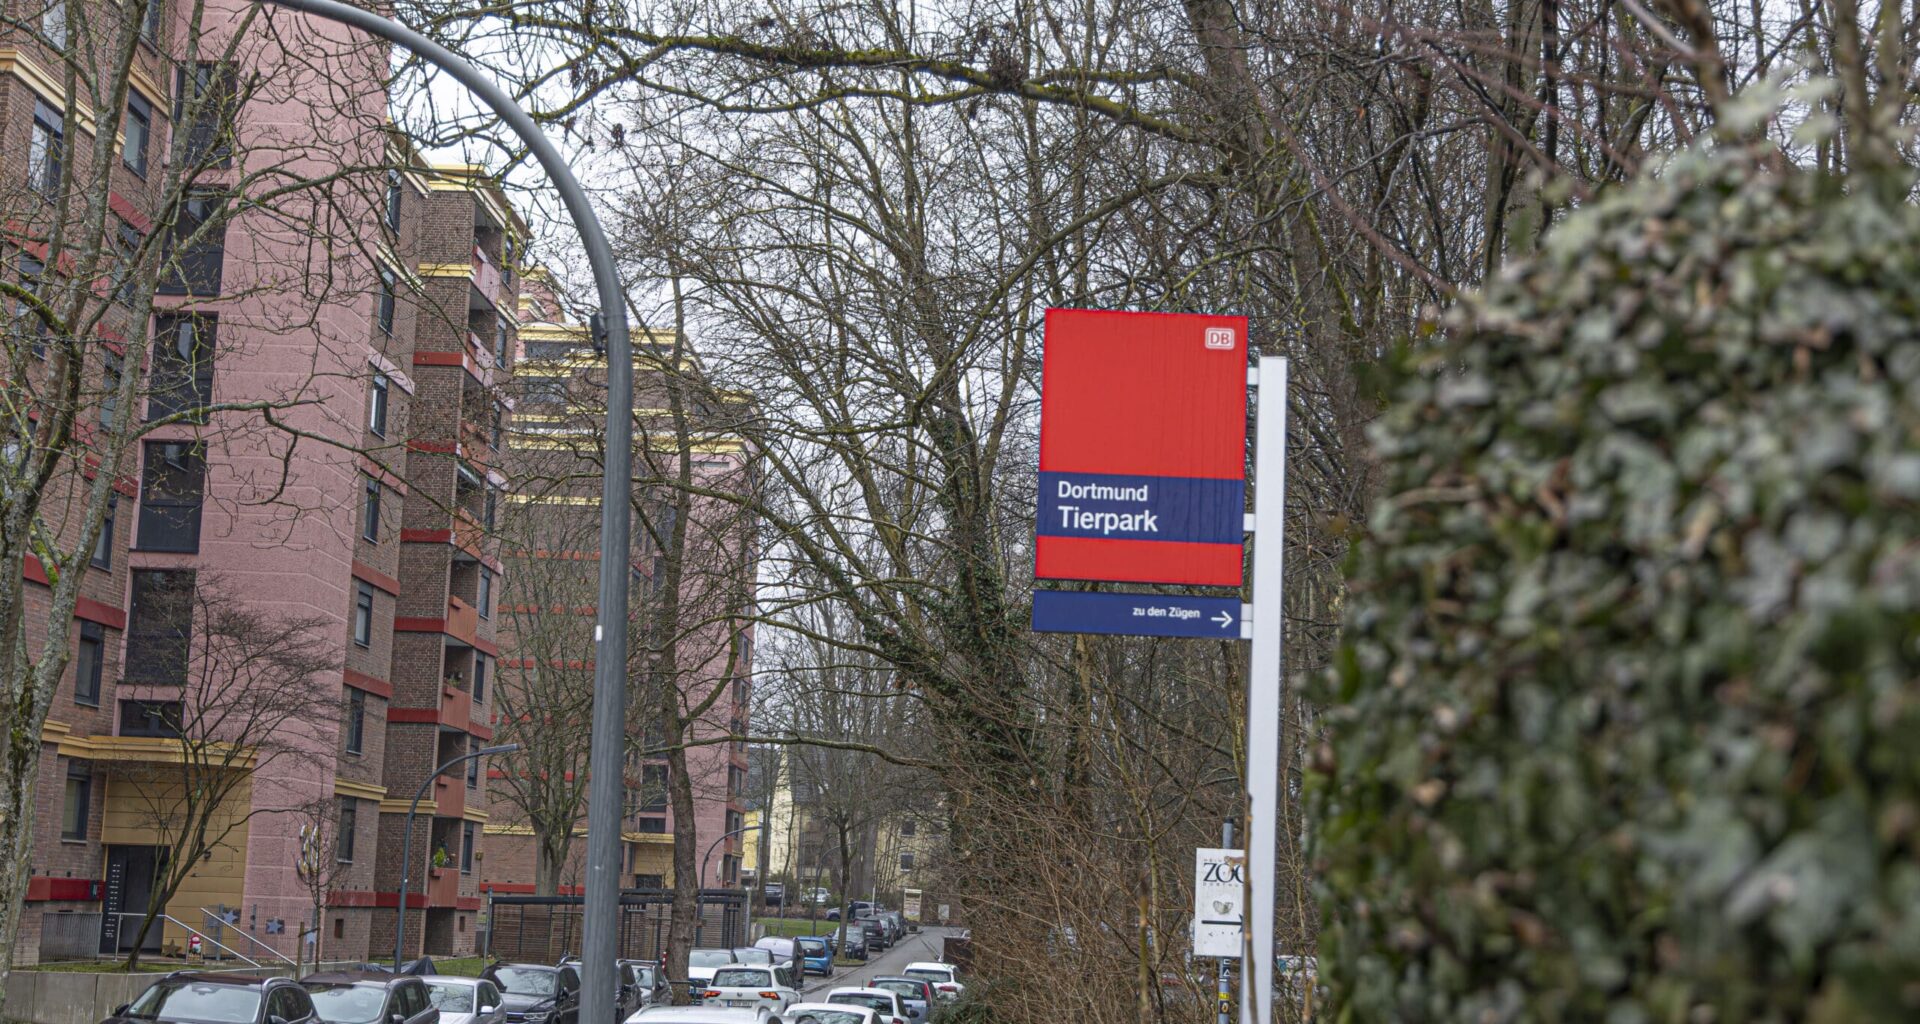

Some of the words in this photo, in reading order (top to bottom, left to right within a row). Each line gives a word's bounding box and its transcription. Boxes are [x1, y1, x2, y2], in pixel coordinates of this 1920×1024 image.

[1210, 332, 1230, 345] DB
[1058, 480, 1148, 501] Dortmund
[1058, 505, 1158, 535] Tierpark
[1132, 607, 1145, 616] zu
[1147, 606, 1166, 617] den
[1168, 606, 1200, 620] Zügen
